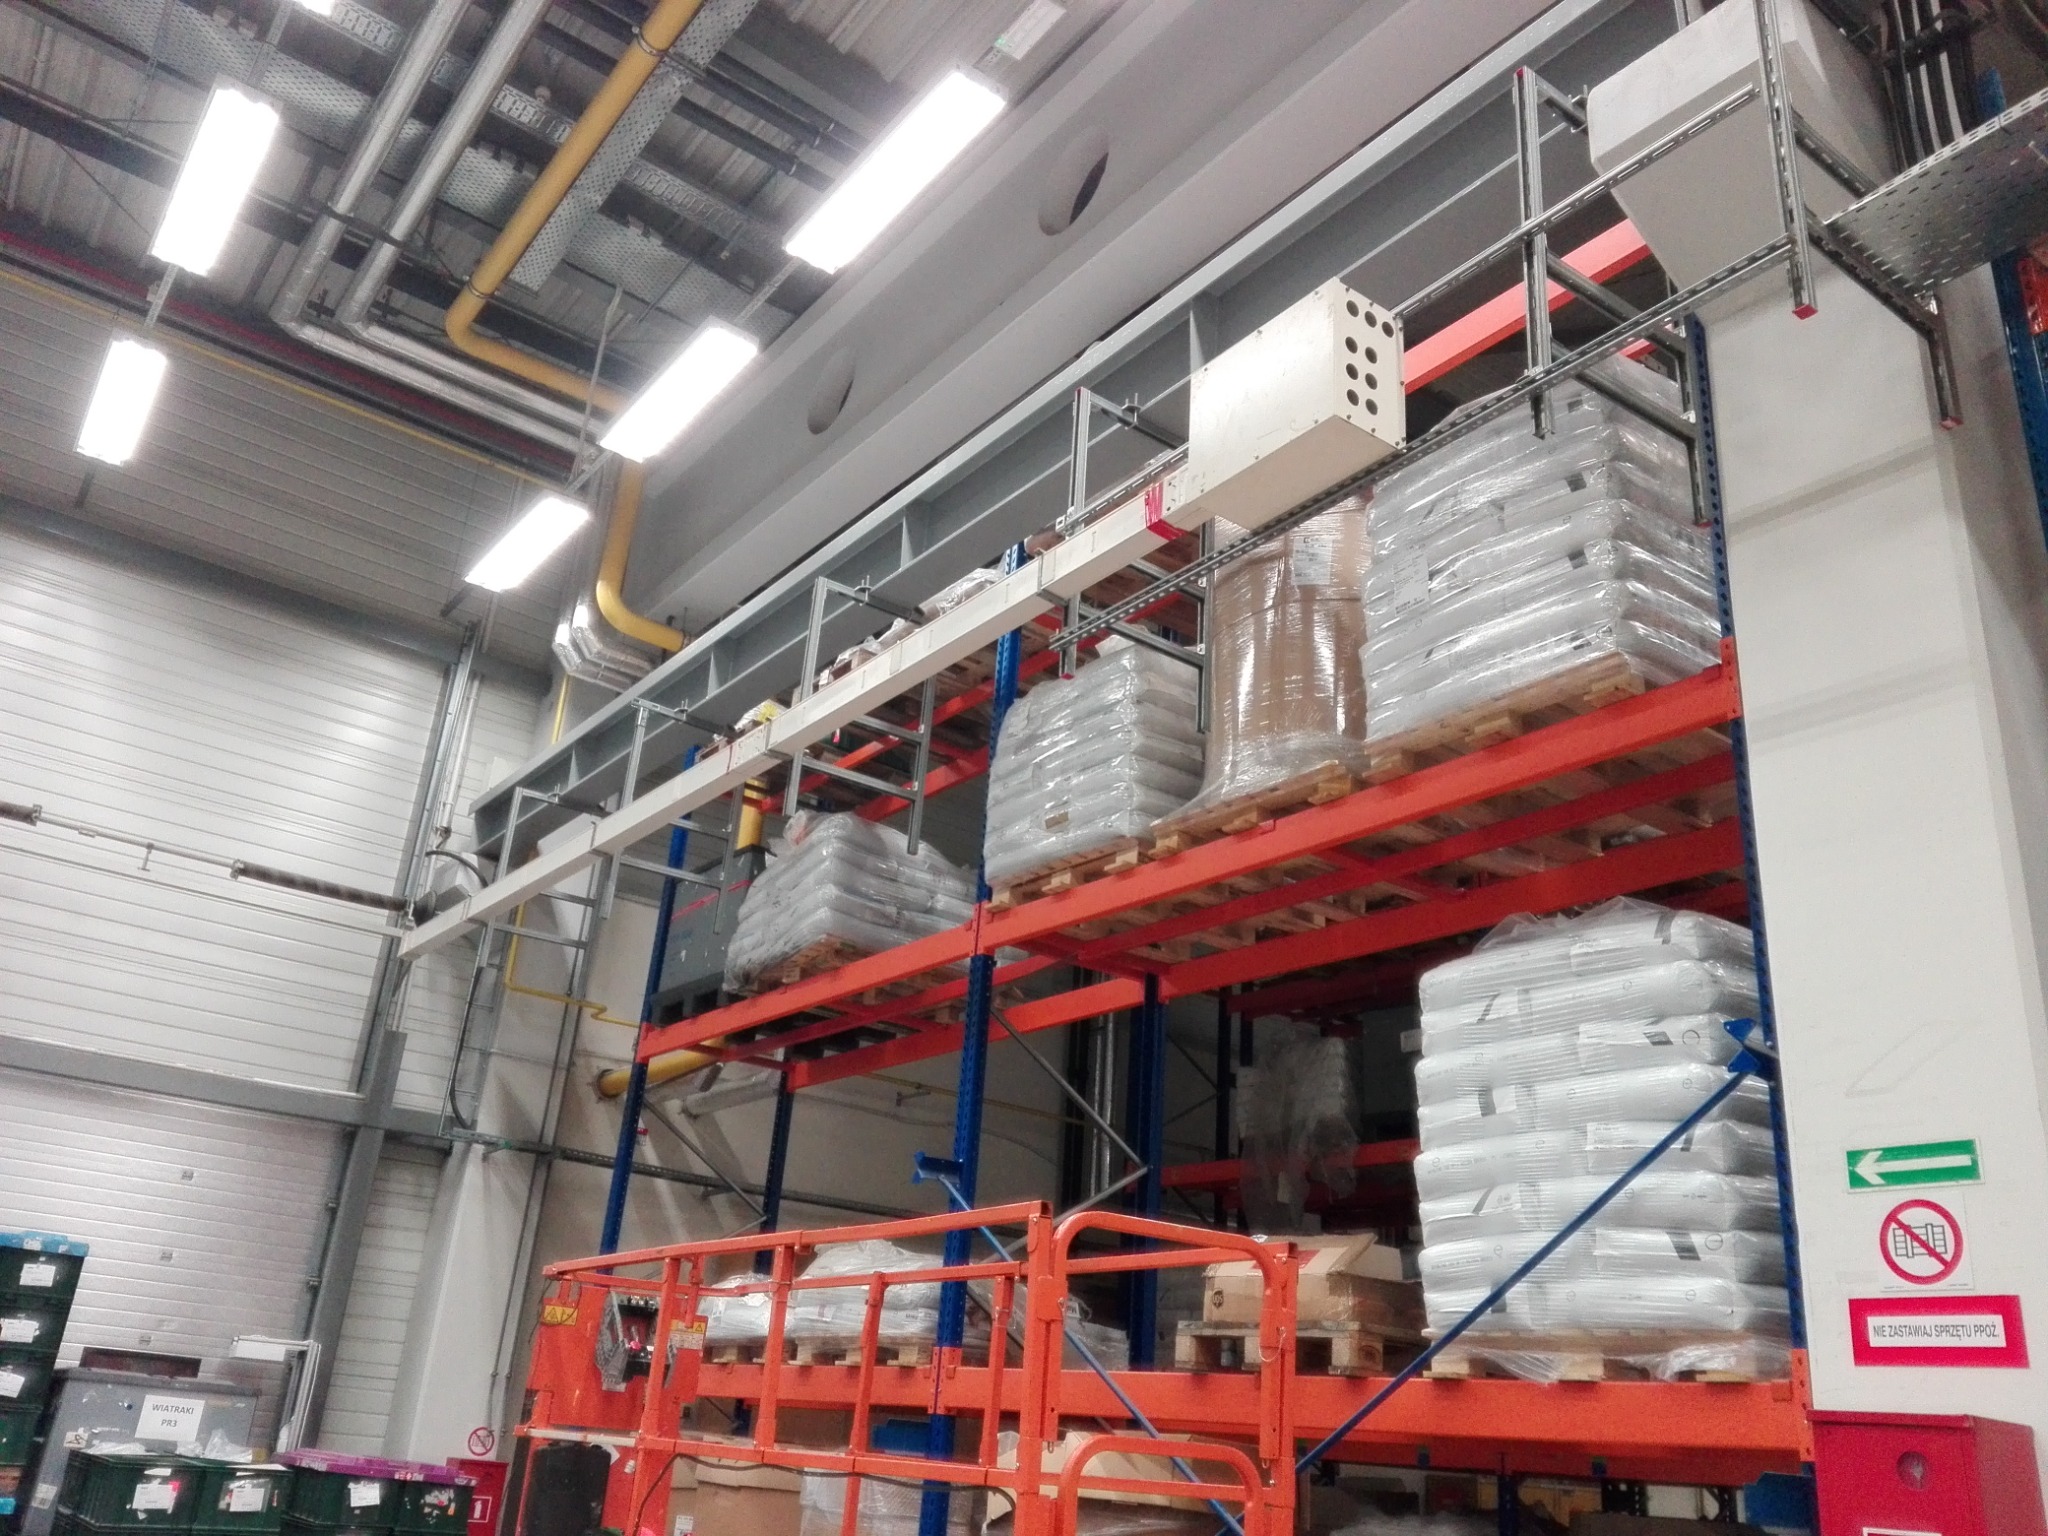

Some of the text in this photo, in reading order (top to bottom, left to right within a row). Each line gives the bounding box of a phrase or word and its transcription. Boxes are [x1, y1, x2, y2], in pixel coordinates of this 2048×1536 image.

[1873, 1325, 1887, 1338] NIE
[1888, 1324, 1933, 1338] ZASTAWIAJ
[1934, 1324, 1972, 1341] SPRZĘTU
[152, 1403, 194, 1414] WIATRAKI
[161, 1419, 177, 1427] PR3
